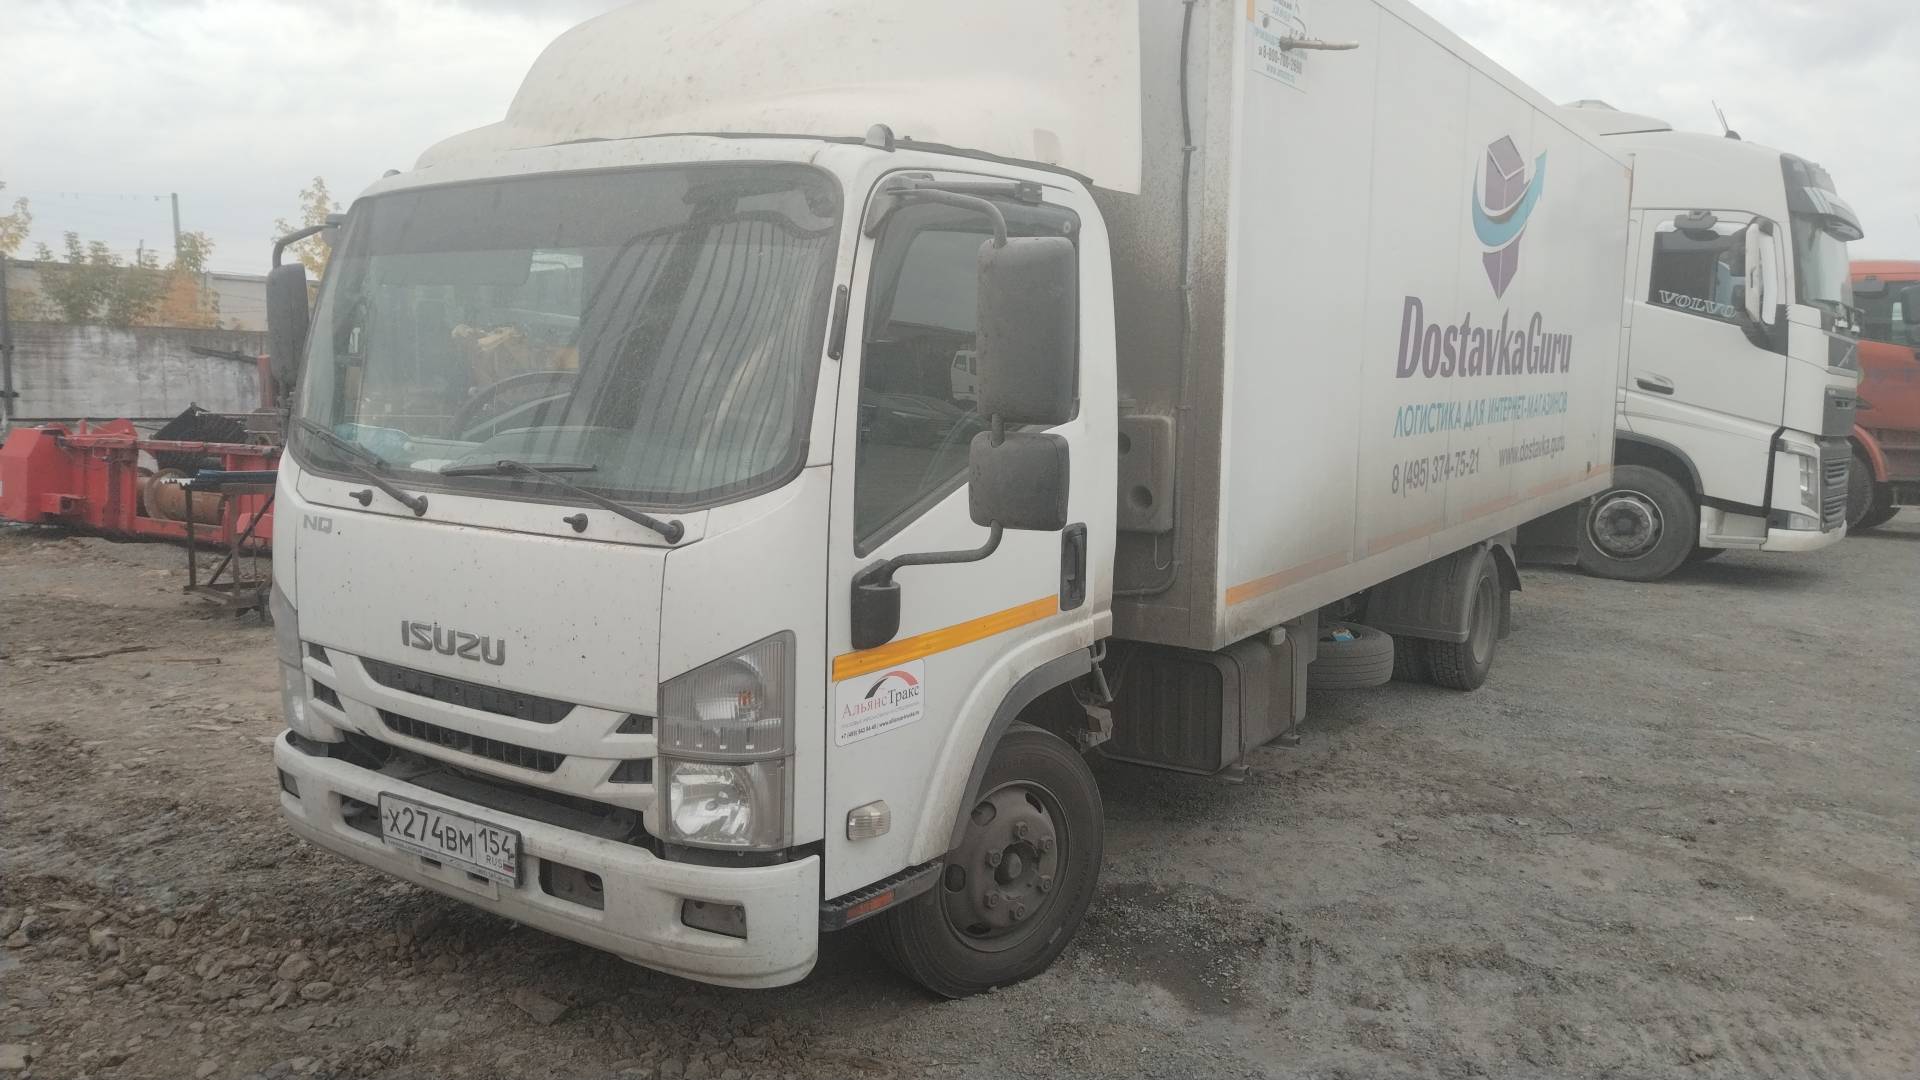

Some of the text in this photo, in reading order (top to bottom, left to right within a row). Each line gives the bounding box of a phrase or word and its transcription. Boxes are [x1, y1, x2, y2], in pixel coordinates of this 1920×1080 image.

[1659, 290, 1737, 318] VOLVO
[1395, 296, 1573, 378] DostavkaGuru
[1393, 391, 1568, 438] ЛОГИСТИКА ДЛЯ ИНТЕРНЕТ-МАГАЗИНОВ
[1499, 435, 1566, 467] www.dostavka.guru
[1391, 447, 1480, 498] 8 (495) 374-75-21
[401, 620, 506, 666] ISUZU
[478, 828, 511, 860] 154
[486, 854, 503, 868] RUS
